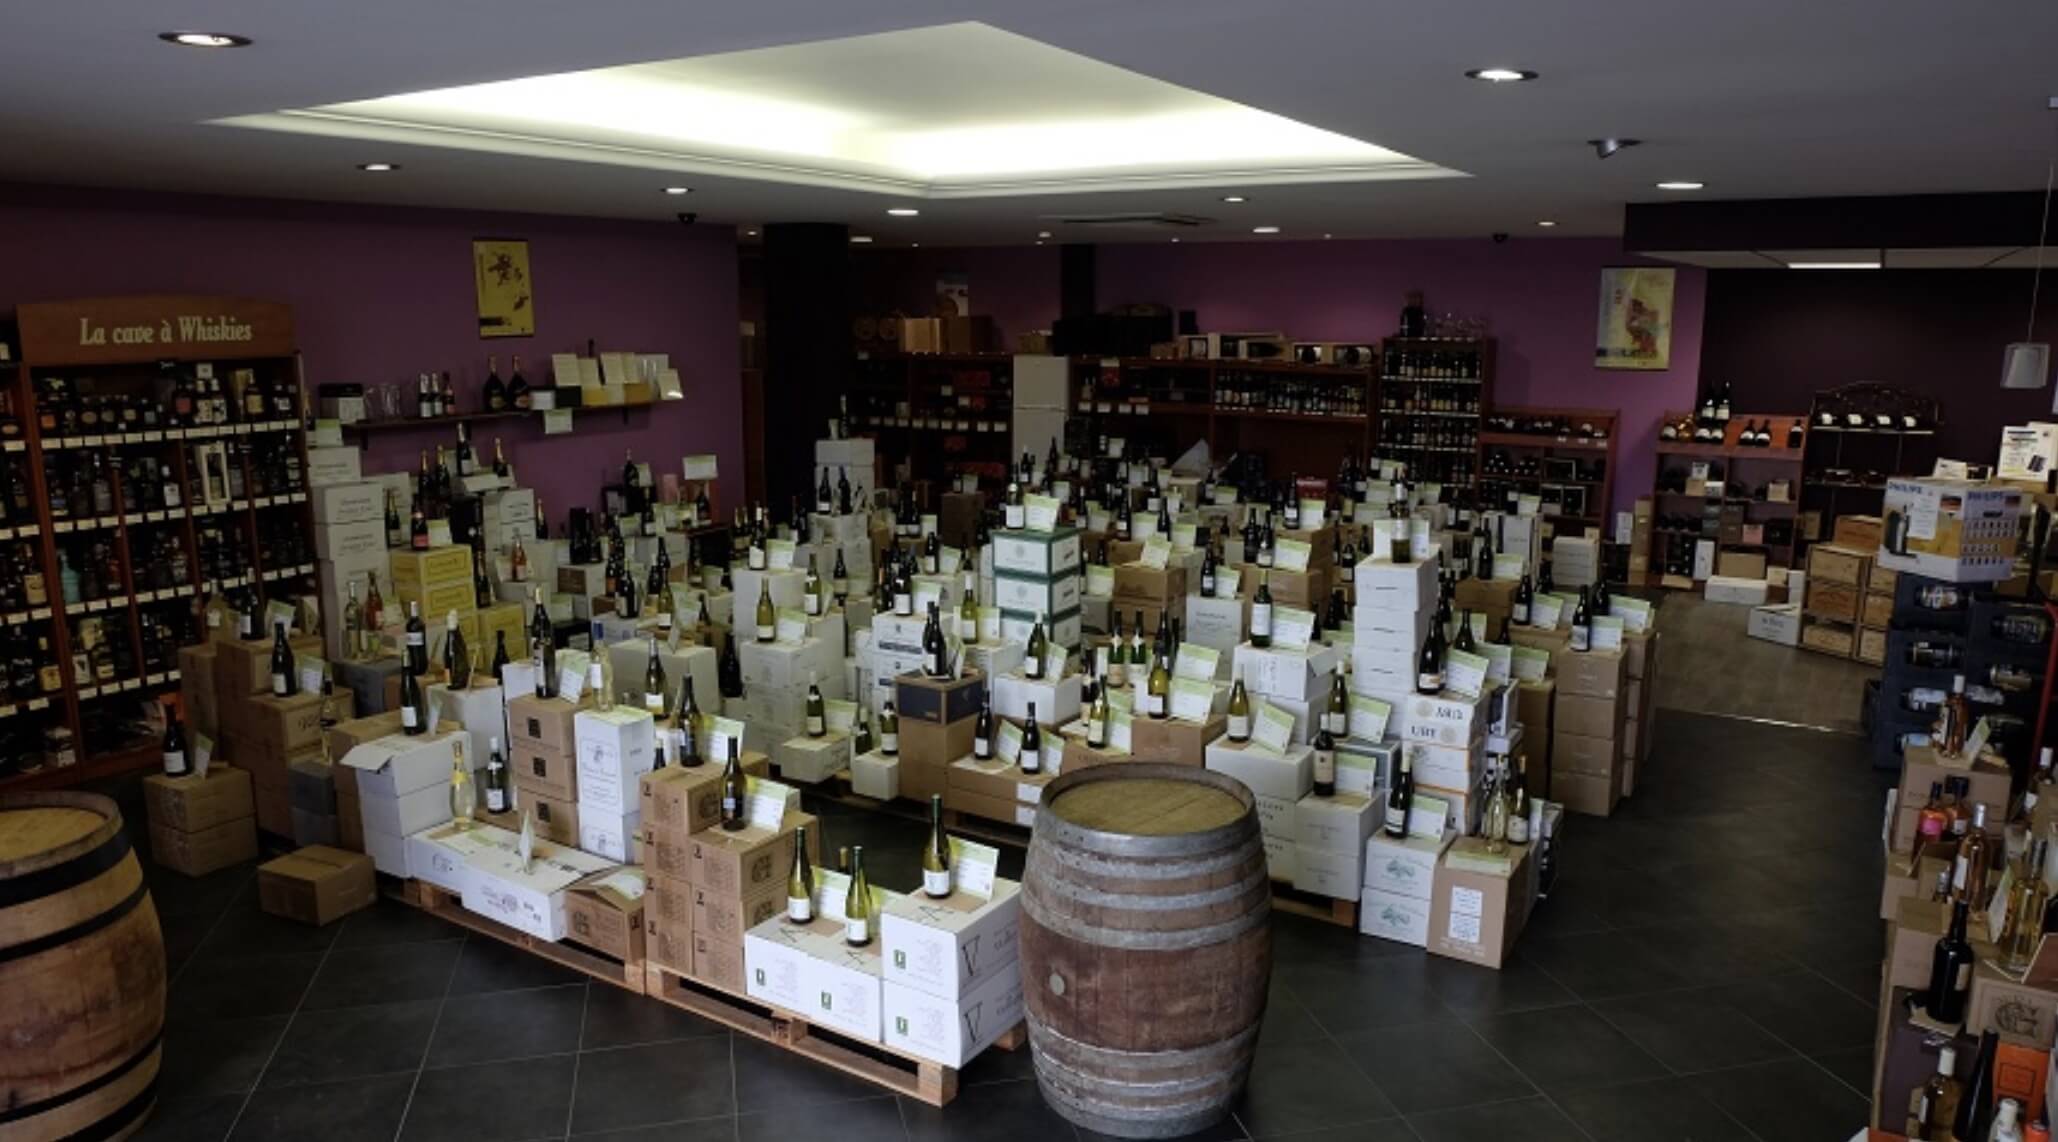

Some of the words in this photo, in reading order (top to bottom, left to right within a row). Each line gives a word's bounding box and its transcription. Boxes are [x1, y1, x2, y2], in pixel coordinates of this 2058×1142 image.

[80, 317, 106, 345] La
[113, 326, 154, 344] cave
[160, 320, 173, 344] à
[178, 316, 252, 342] Whiskies
